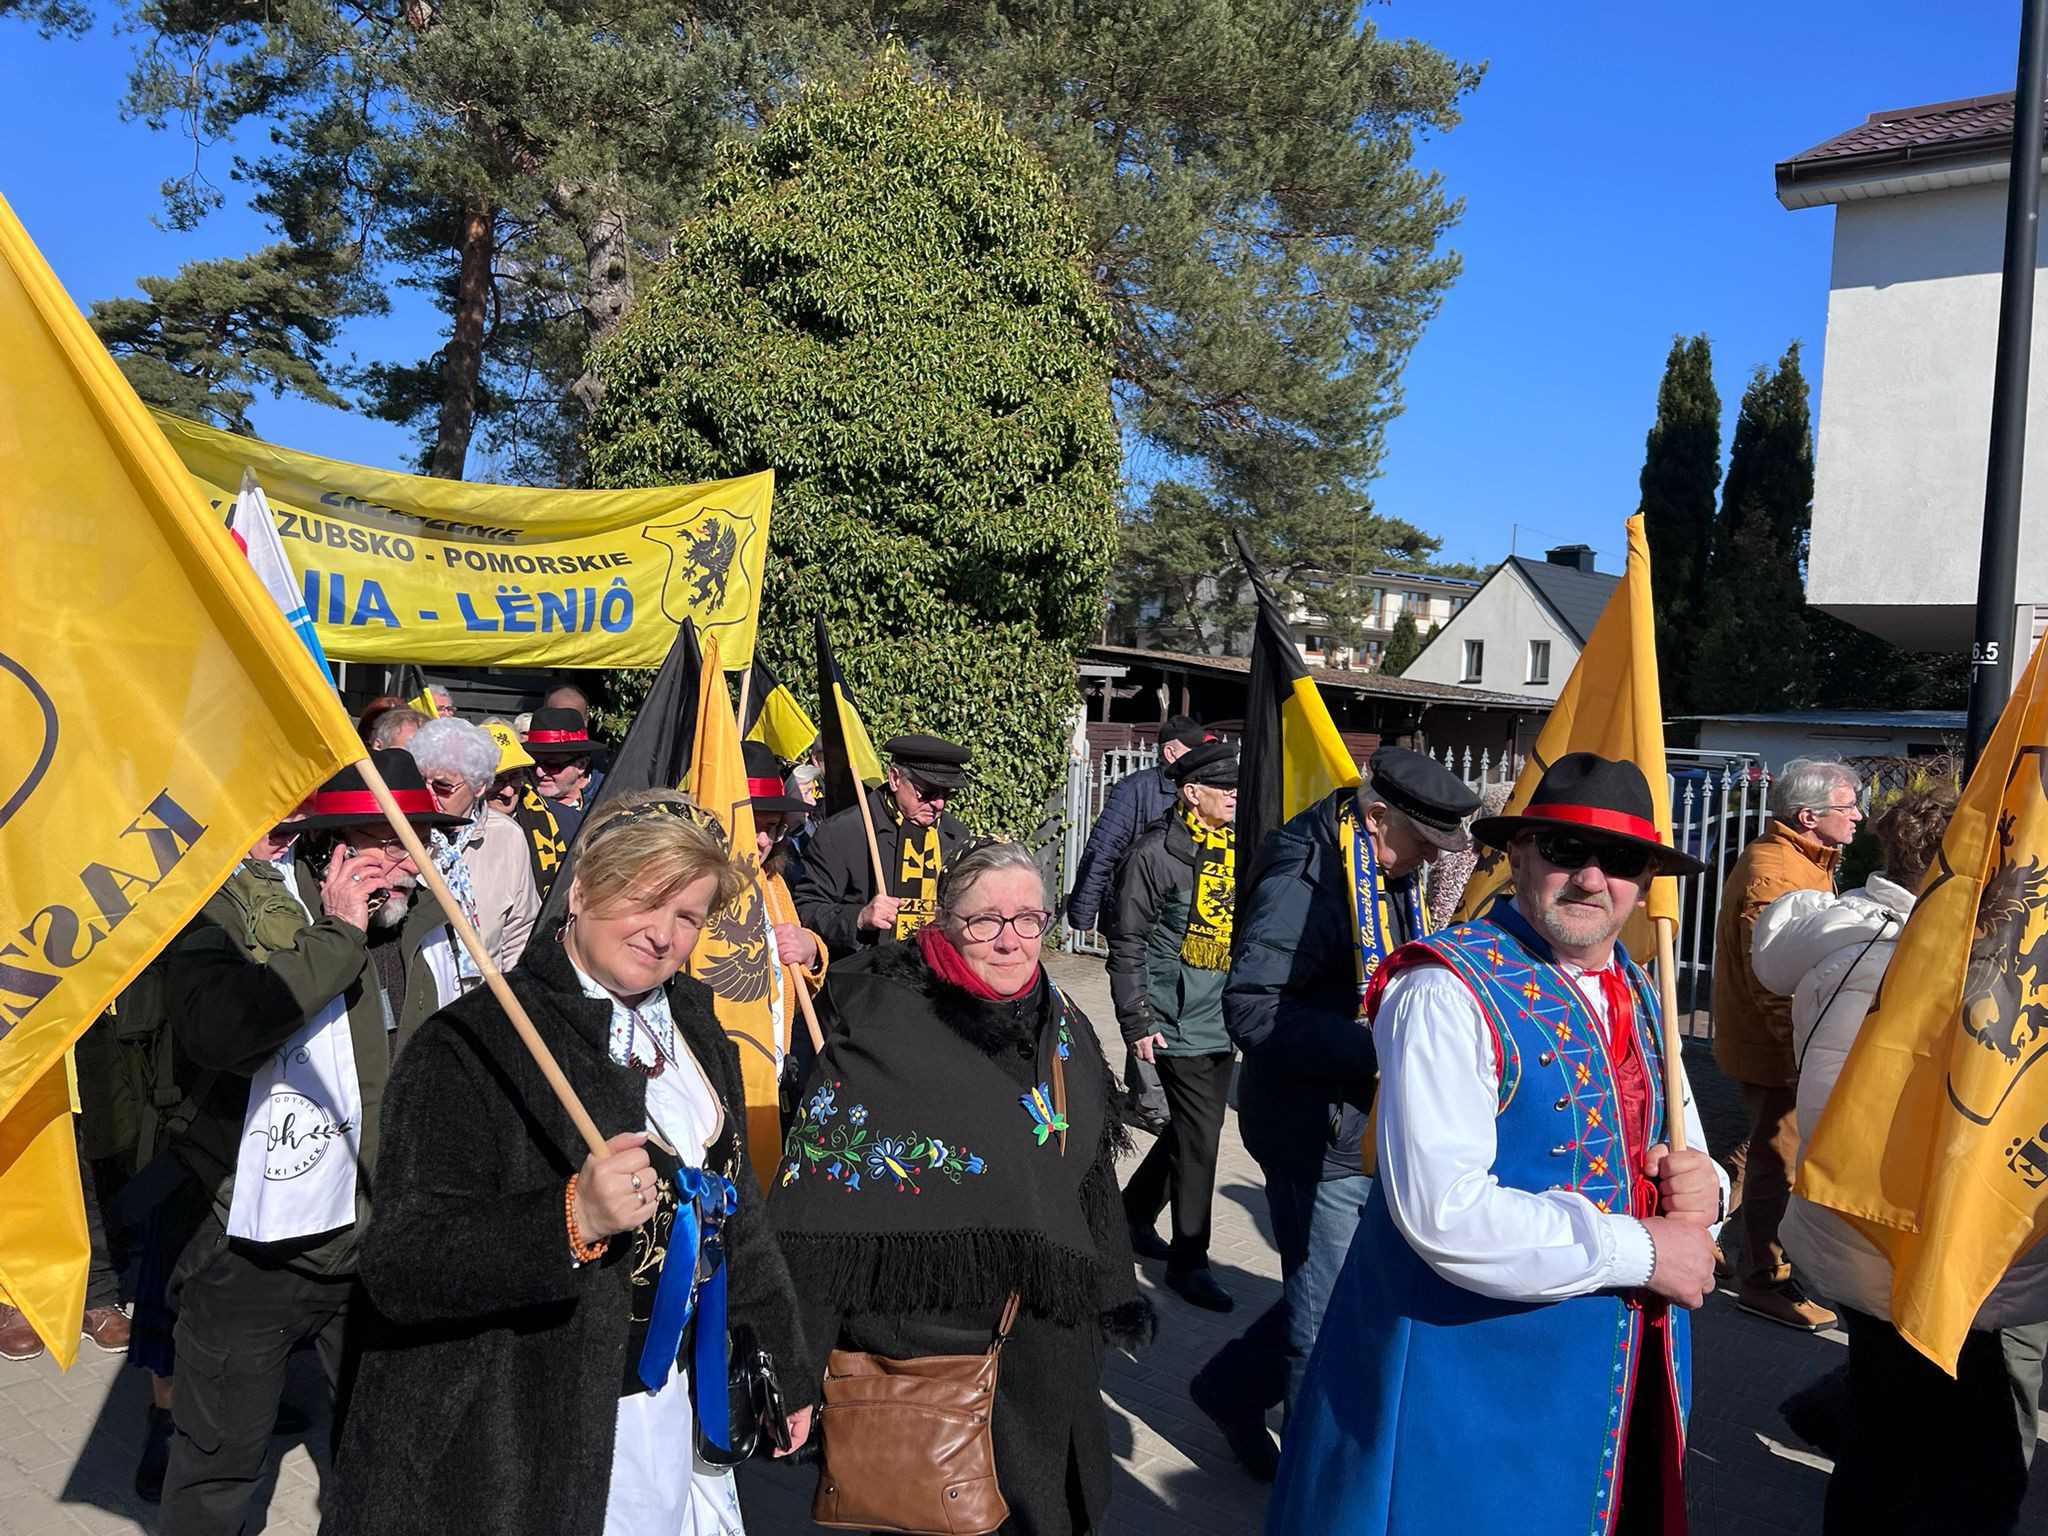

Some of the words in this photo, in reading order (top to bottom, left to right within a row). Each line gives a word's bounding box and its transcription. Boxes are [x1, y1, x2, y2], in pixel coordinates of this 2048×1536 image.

[443, 546, 633, 574] POMORSKIE
[456, 577, 635, 633] LËNIÔ
[275, 1096, 315, 1114] GDYNIA
[294, 1147, 322, 1172] KACK
